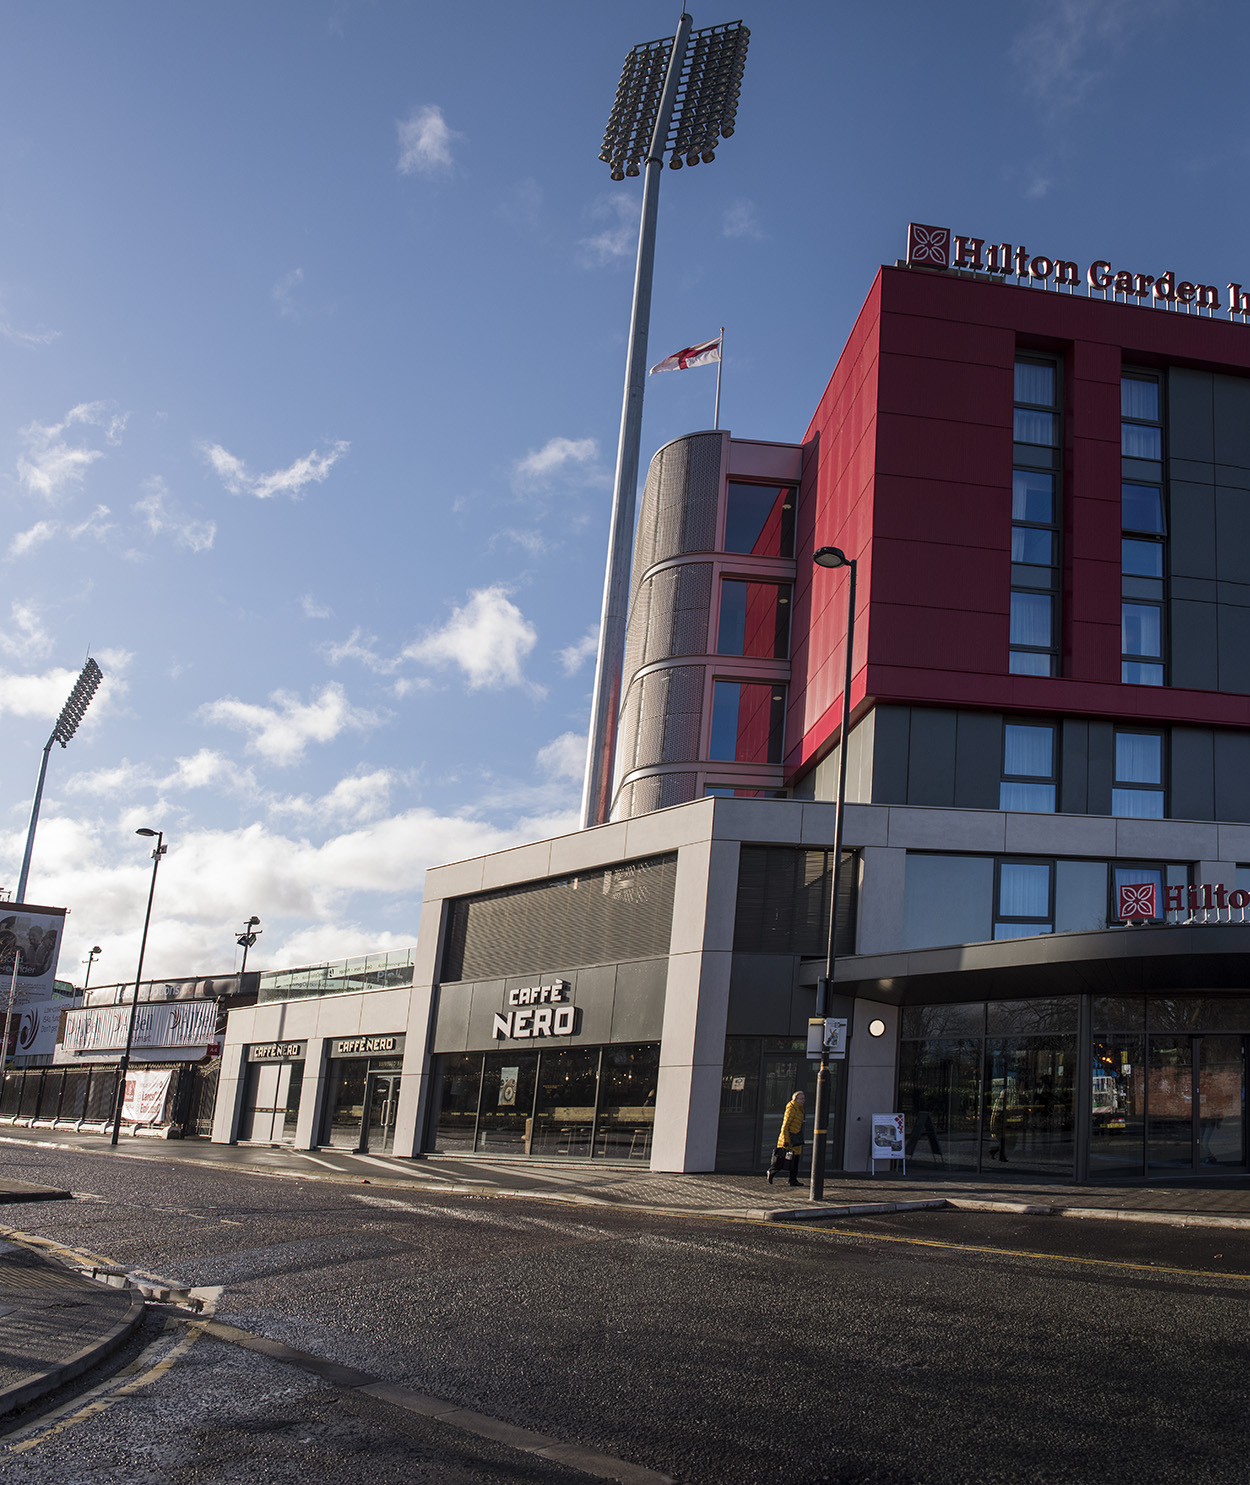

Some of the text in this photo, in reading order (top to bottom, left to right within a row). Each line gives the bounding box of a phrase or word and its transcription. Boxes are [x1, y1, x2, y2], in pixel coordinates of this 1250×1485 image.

[953, 235, 1080, 286] Hilton
[1087, 260, 1221, 309] Garden
[509, 978, 564, 1007] CAFFÈ
[492, 1006, 576, 1039] NERO
[276, 1044, 298, 1057] NERO
[337, 1037, 393, 1053] CAFFÈ NERO
